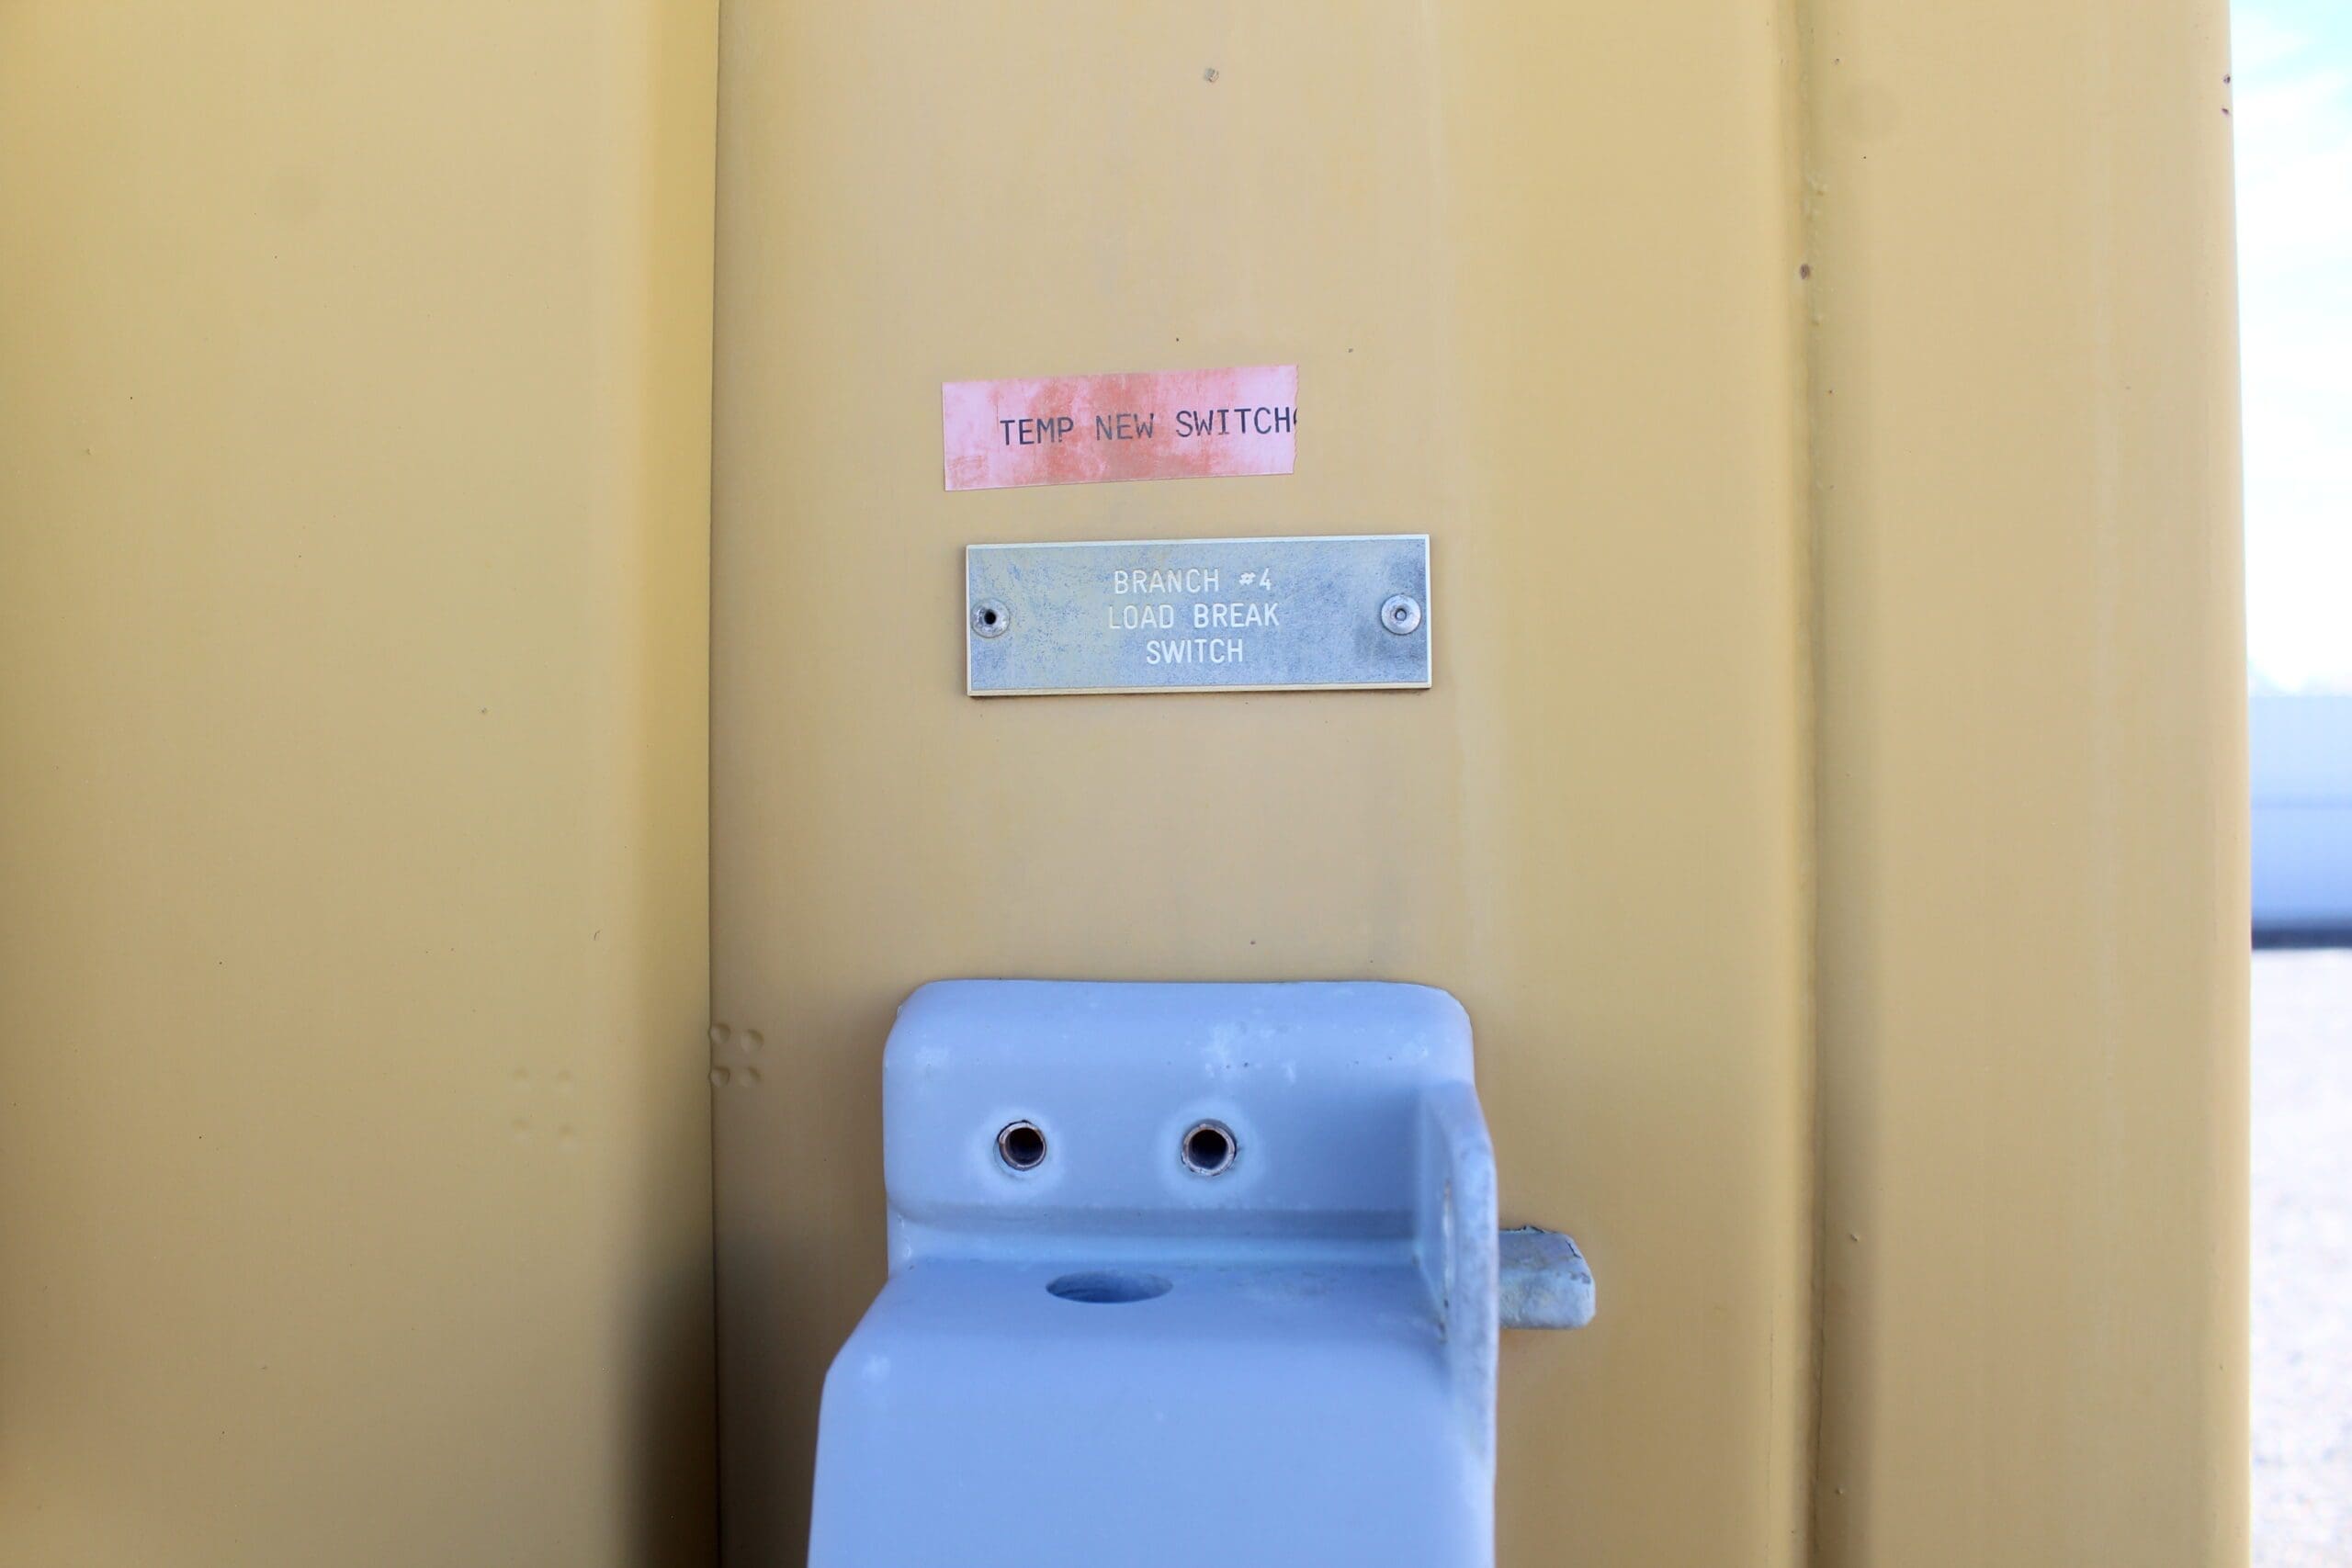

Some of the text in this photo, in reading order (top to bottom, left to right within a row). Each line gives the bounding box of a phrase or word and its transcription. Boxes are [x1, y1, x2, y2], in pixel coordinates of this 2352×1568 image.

[1000, 406, 1297, 446] TEMP NEW SWITCH
[1114, 568, 1272, 594] BRANCH #4
[1109, 603, 1279, 629] LOAD BREAK
[1146, 638, 1243, 664] SWITCH
